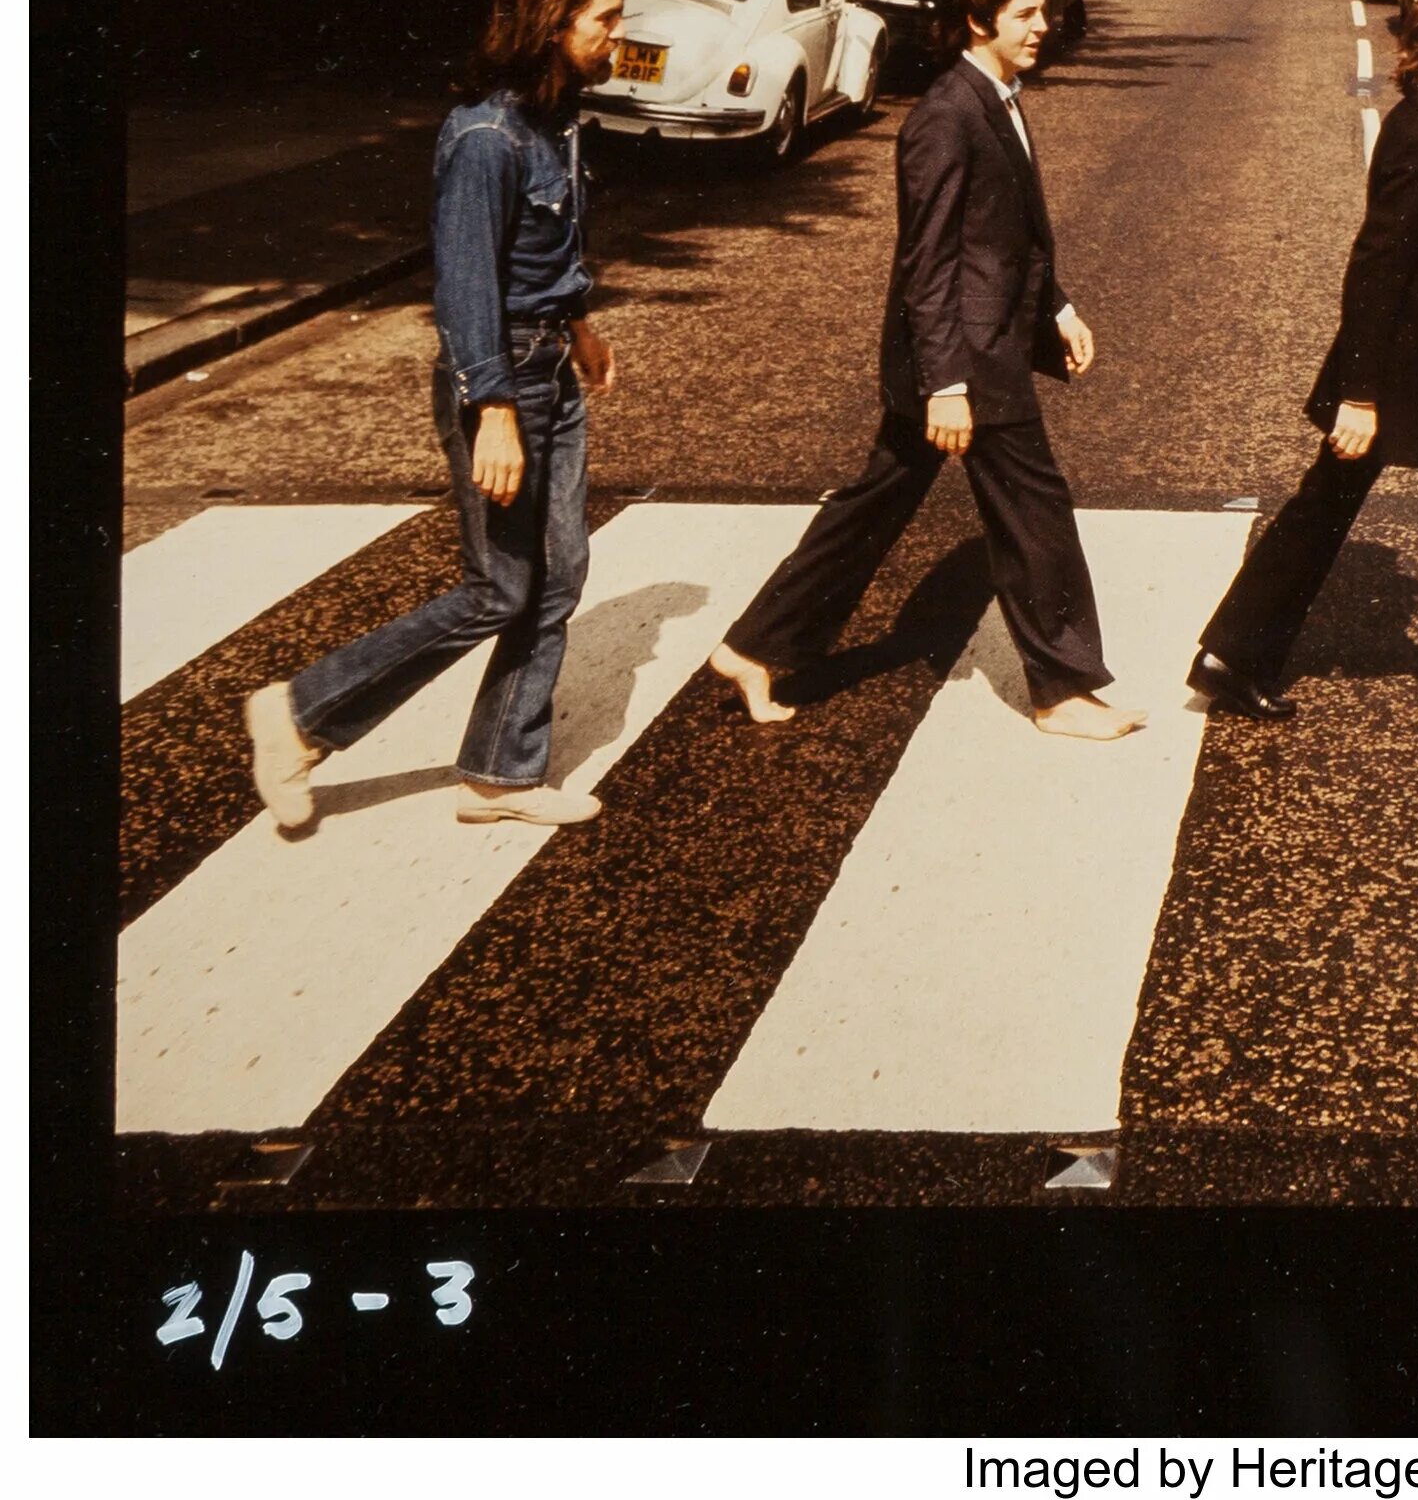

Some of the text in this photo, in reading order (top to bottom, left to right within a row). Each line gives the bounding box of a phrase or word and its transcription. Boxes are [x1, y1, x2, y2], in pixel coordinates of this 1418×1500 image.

[624, 46, 661, 63] LMW
[618, 64, 660, 81] 281F
[156, 1250, 312, 1371] 2/5
[426, 1261, 476, 1326] 3
